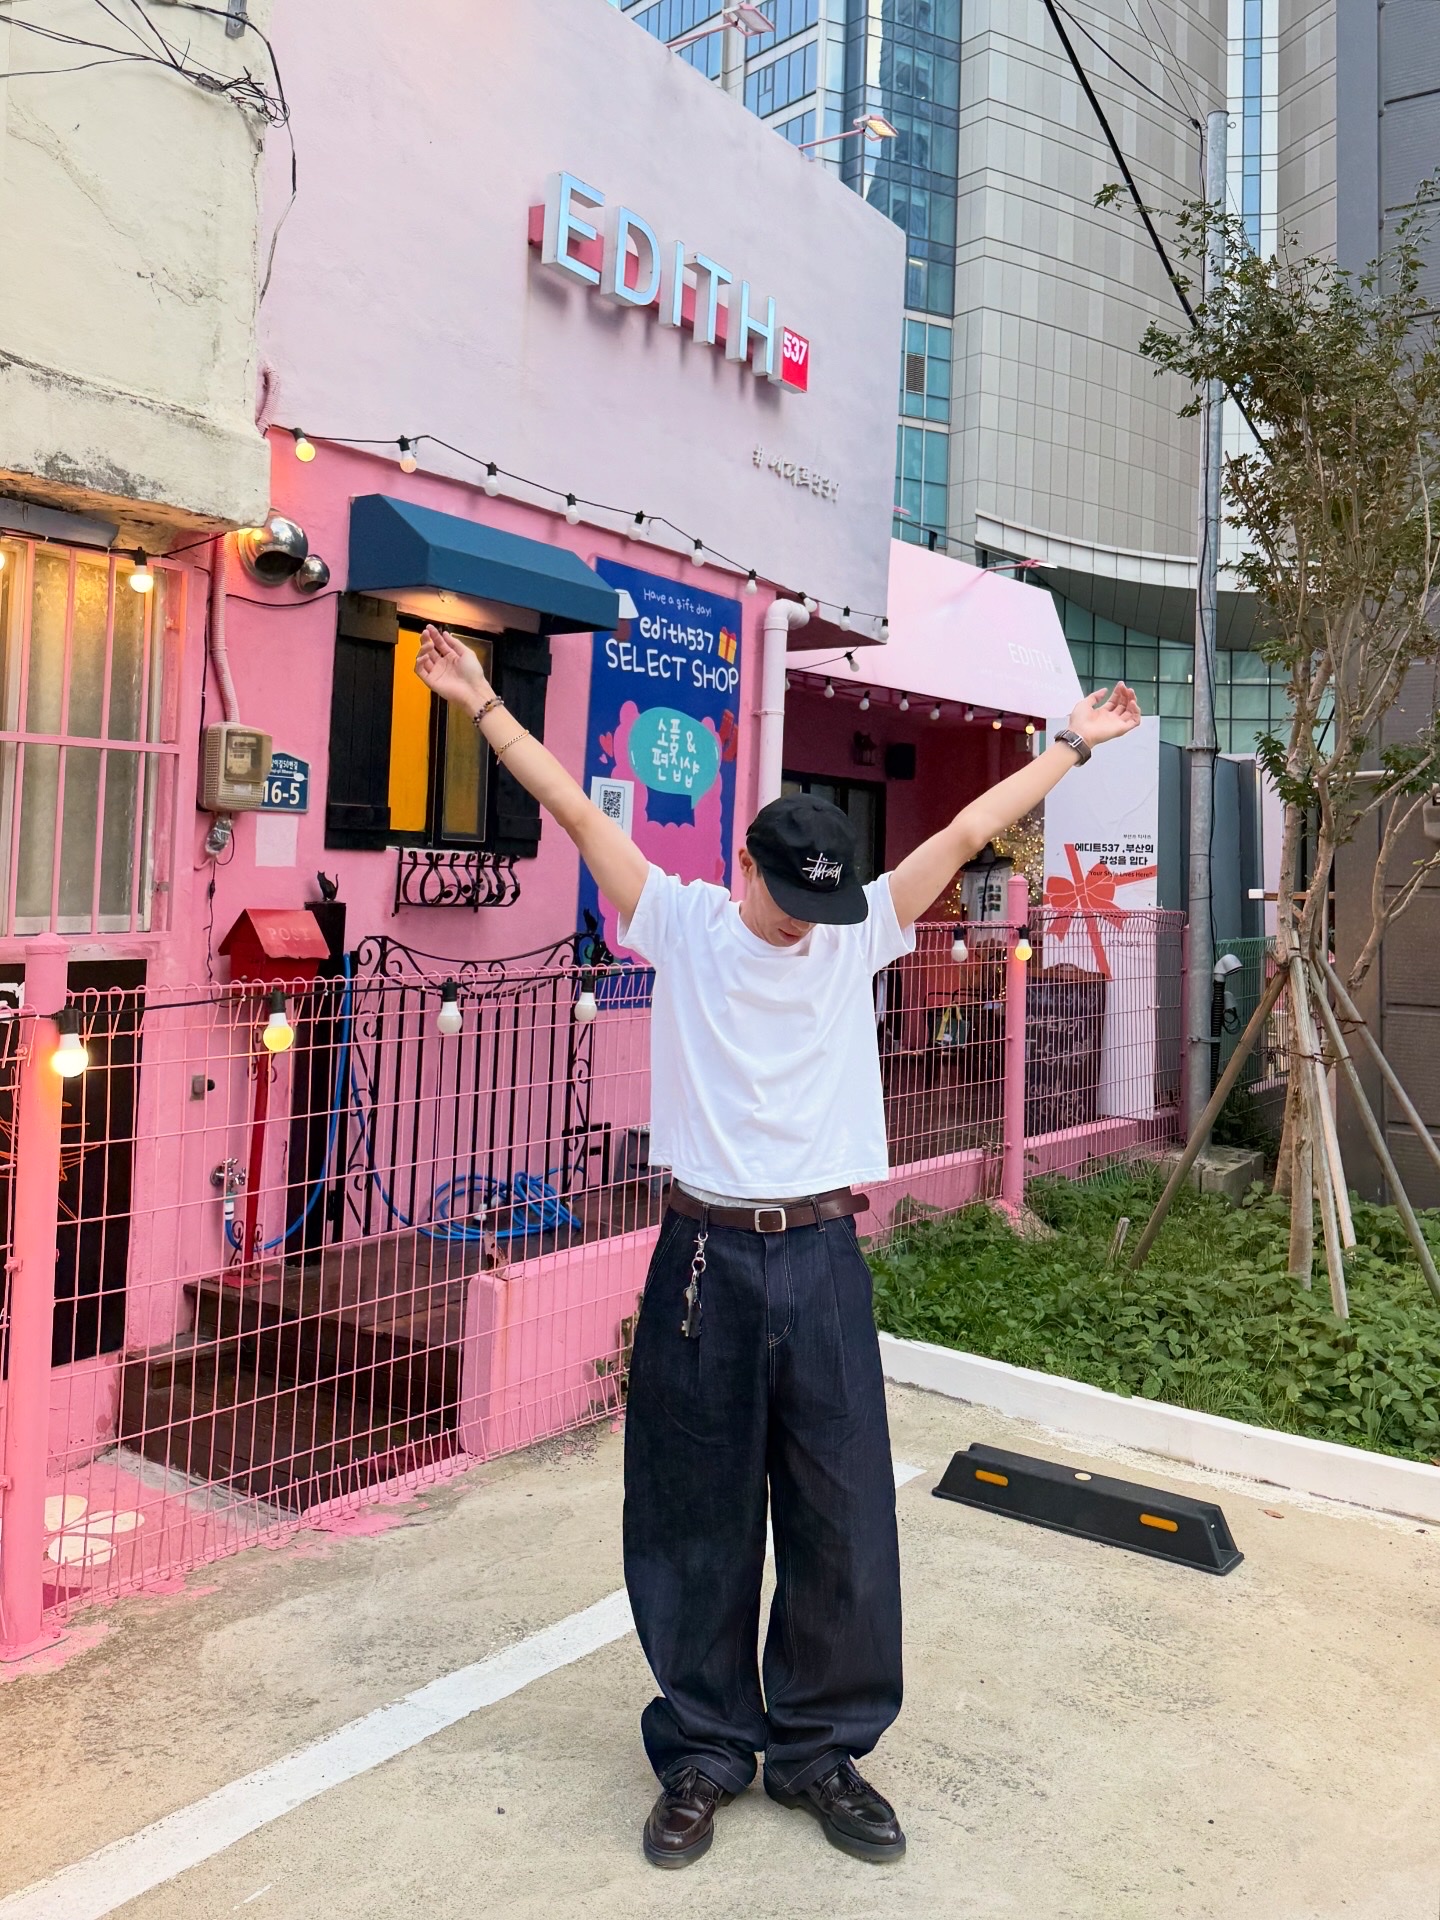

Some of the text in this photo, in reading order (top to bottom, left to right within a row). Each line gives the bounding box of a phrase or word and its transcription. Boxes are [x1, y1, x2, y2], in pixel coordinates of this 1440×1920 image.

[542, 171, 809, 377] EDITH 537
[643, 587, 712, 618] Have a gift day!
[639, 615, 714, 655] edith537
[605, 638, 740, 694] SELECT SHOP
[1008, 641, 1055, 673] EDITH
[656, 717, 697, 754] 소품 &
[651, 747, 701, 789] 편집샵
[263, 780, 301, 805] 16-5
[1074, 843, 1120, 853] 에디트537
[1099, 856, 1148, 866] 감성을 입다
[266, 927, 312, 941] POST
